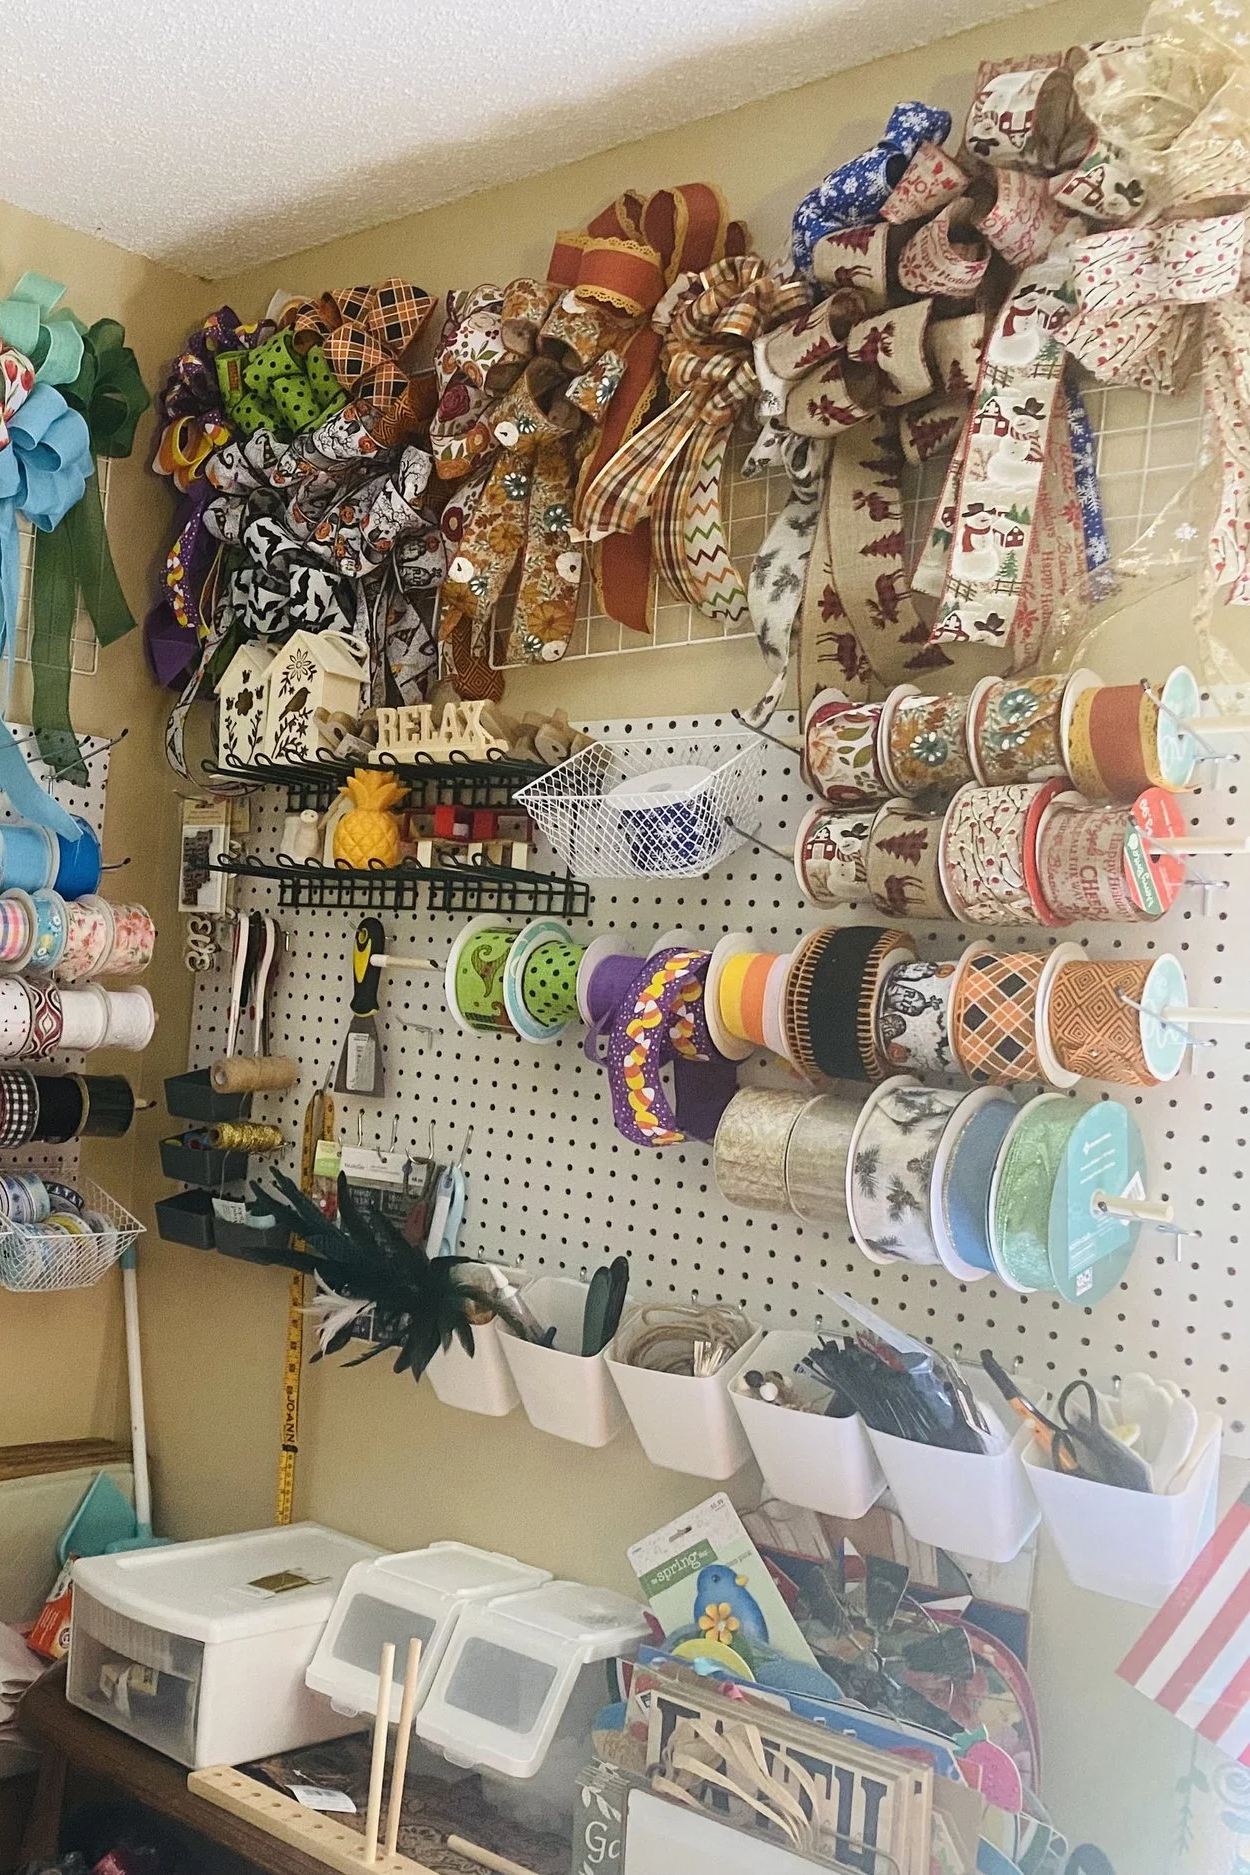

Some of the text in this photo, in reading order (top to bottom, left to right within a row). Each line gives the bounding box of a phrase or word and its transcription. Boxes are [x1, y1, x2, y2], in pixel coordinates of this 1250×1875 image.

[376, 700, 496, 750] RELAX
[286, 1396, 295, 1443] JOANN
[657, 1551, 701, 1584] spring
[657, 1697, 888, 1875] FTH
